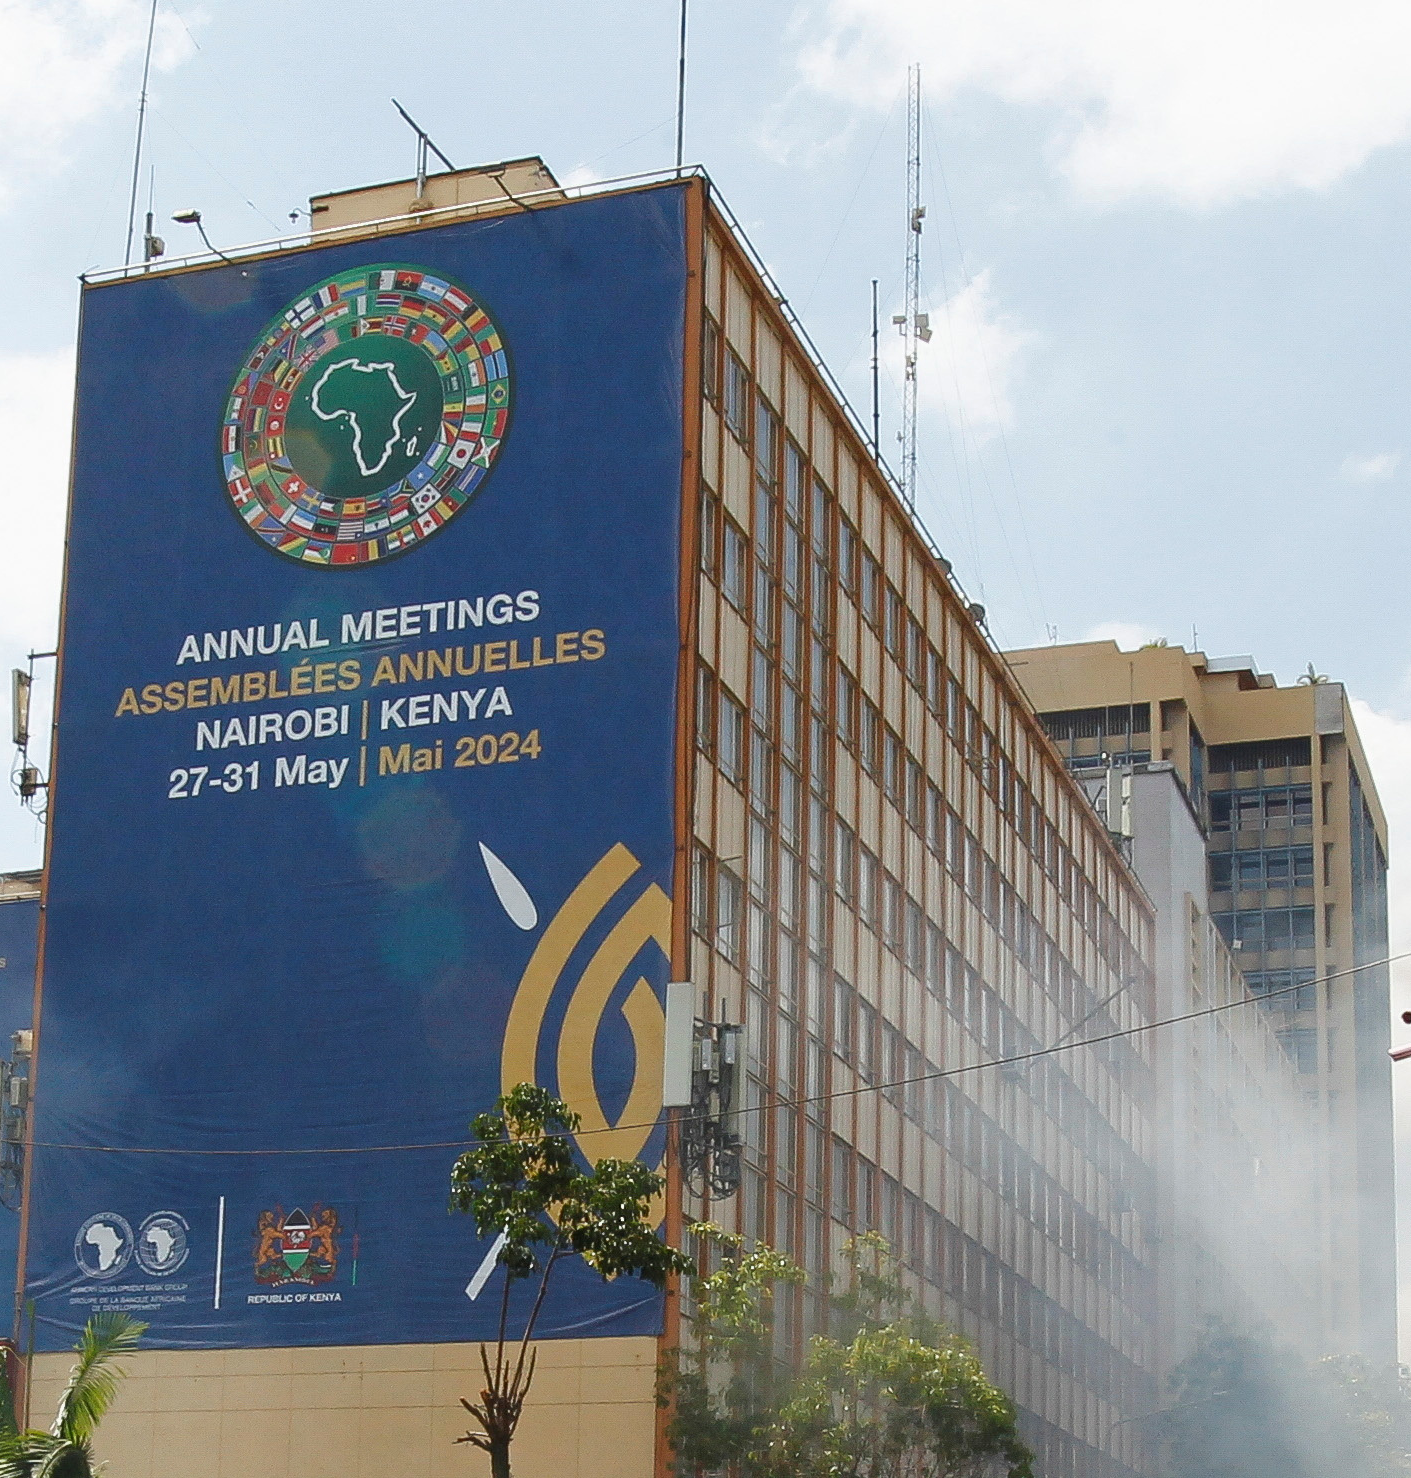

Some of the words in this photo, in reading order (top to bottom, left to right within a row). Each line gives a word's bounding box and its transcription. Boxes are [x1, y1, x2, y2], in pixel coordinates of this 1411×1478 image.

[176, 618, 330, 666] ANNUAL
[340, 590, 540, 645] MEETINGS
[114, 657, 362, 718] ASSEMBLÉES
[370, 628, 607, 688] ANNUELLES
[195, 704, 350, 751] NAIROBI
[380, 686, 514, 731] KENYA
[167, 760, 261, 799] 27-31
[274, 754, 350, 790] May
[377, 740, 443, 776] Mai
[453, 728, 543, 769] 2024
[247, 1293, 293, 1304] REPUBLIC
[294, 1293, 309, 1303] OF
[309, 1292, 342, 1302] KENYA
